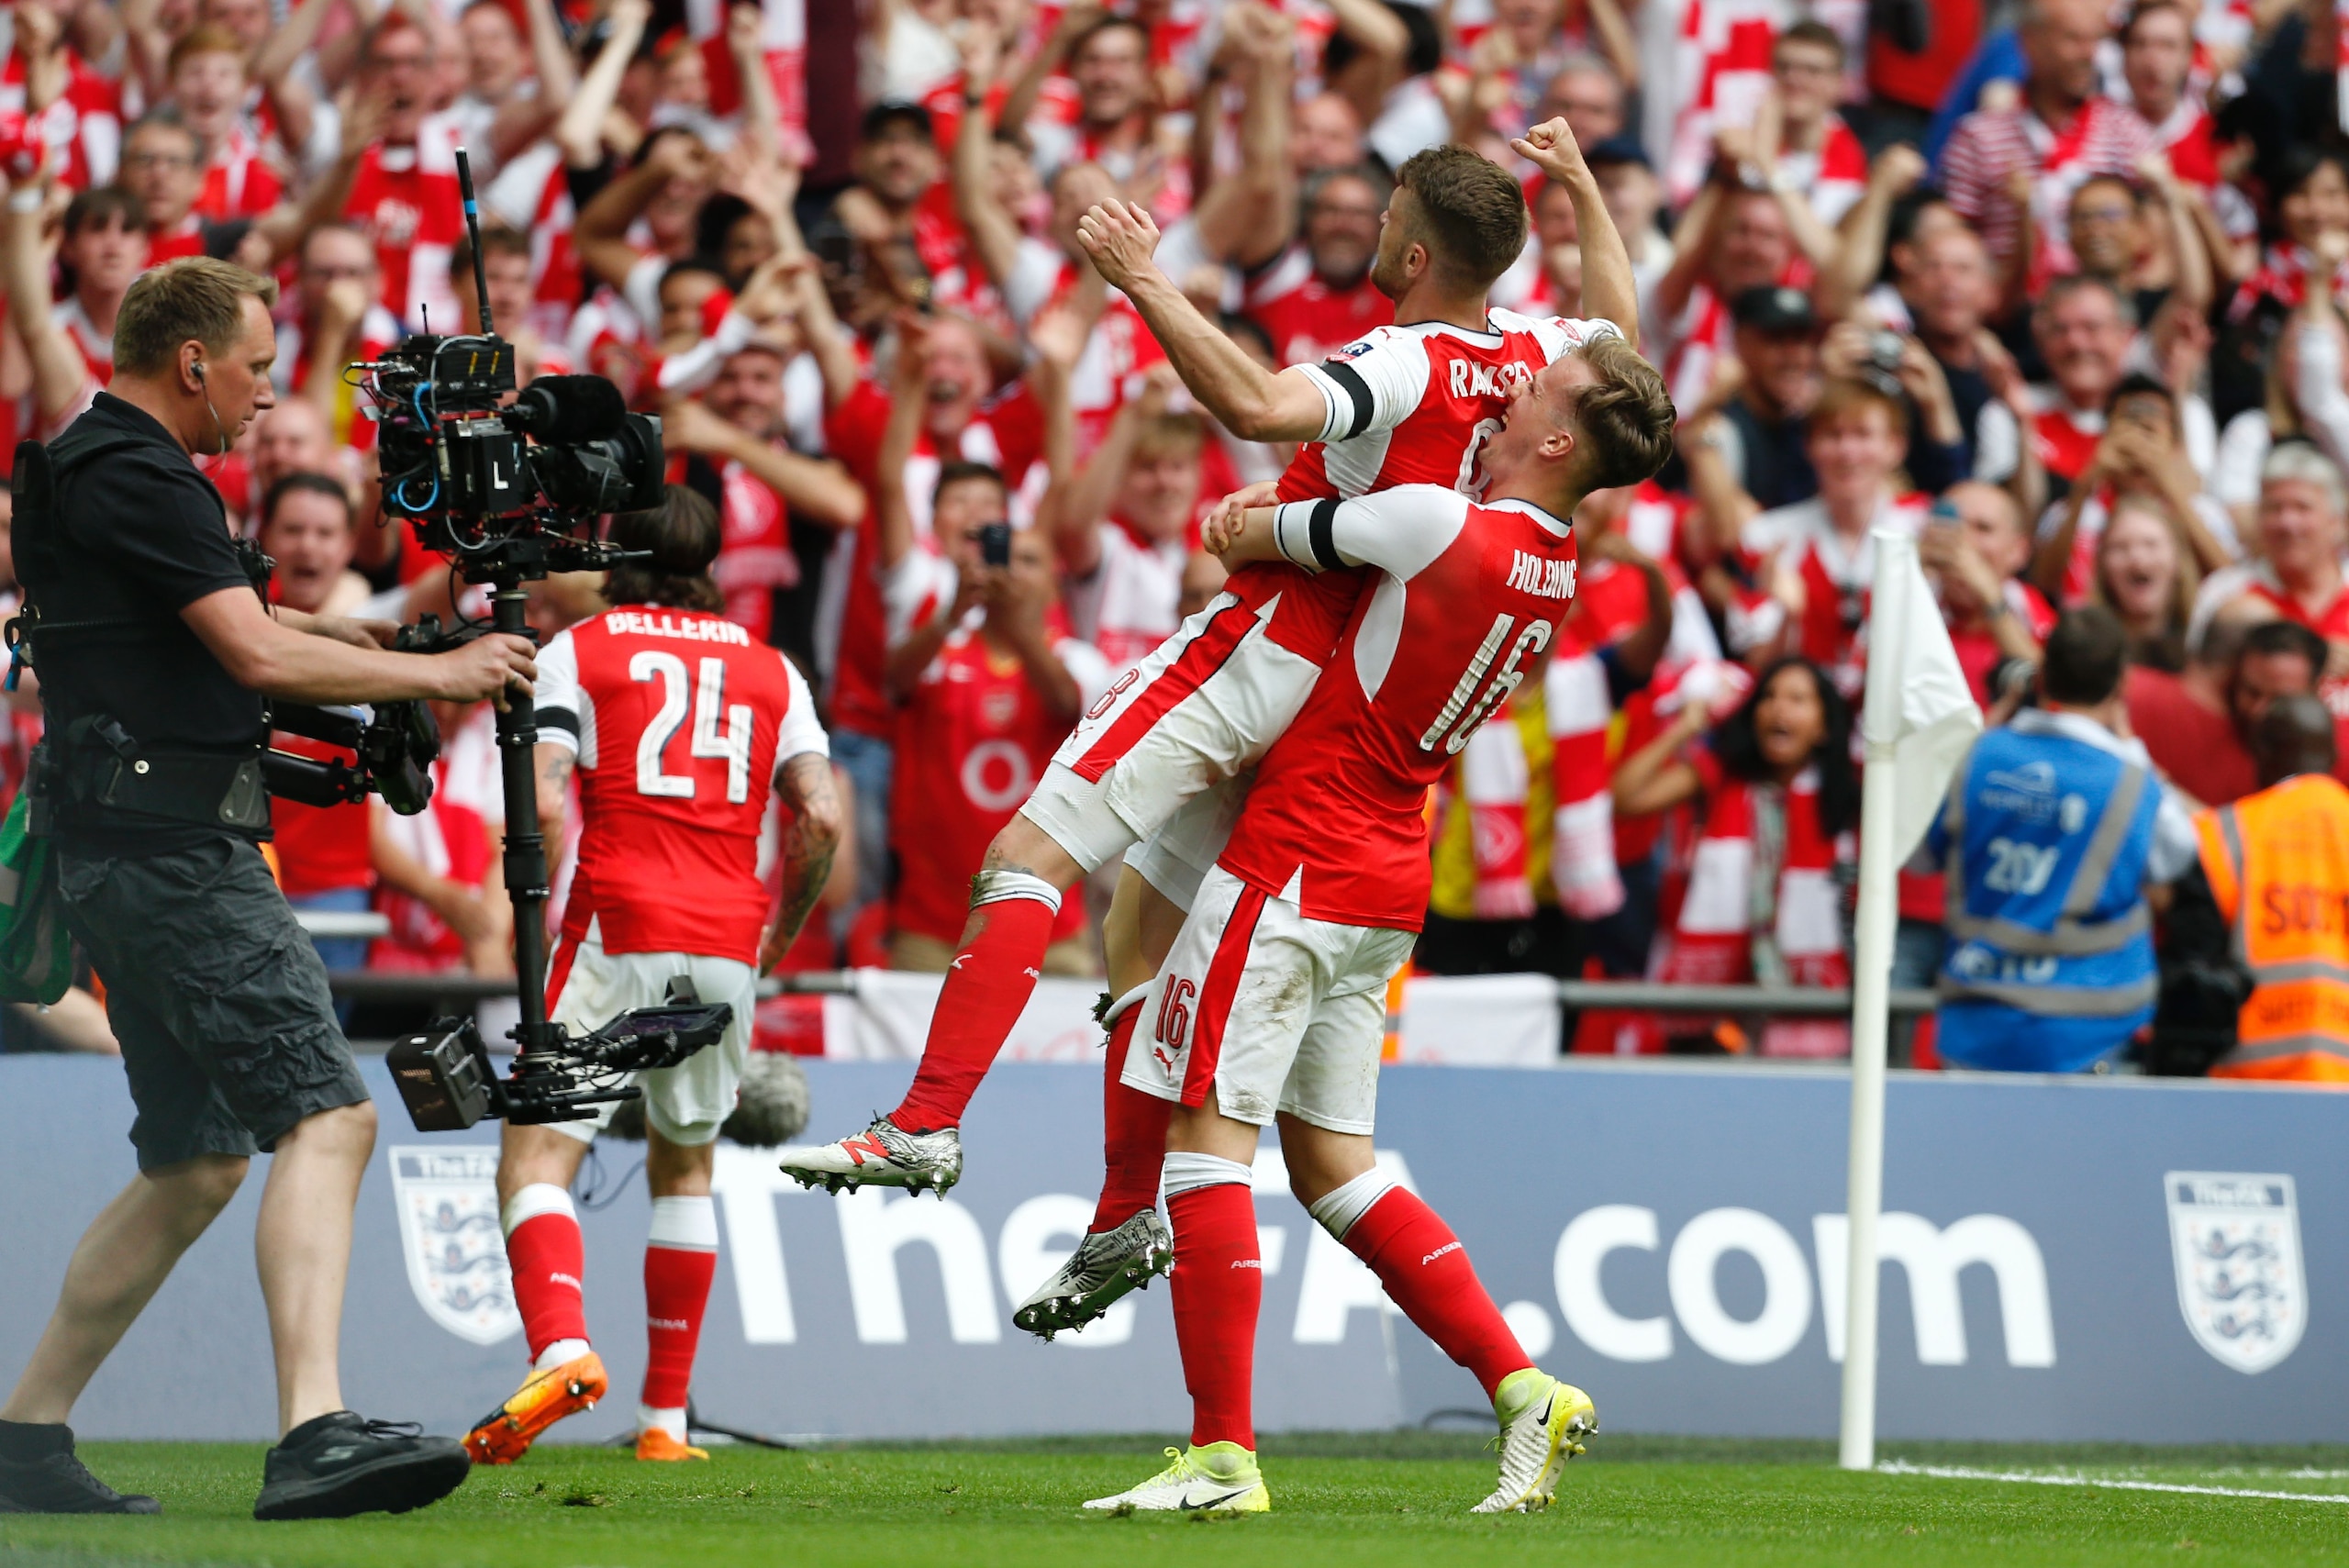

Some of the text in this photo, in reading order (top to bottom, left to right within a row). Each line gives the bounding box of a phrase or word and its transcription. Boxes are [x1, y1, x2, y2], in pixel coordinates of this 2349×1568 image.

[493, 462, 509, 489] L
[1506, 549, 1577, 599] HOLDING
[605, 612, 750, 647] BELLERIN
[1085, 668, 1140, 720] 8
[1419, 612, 1553, 755] 16
[629, 650, 753, 805] 24
[1156, 973, 1196, 1050] 16
